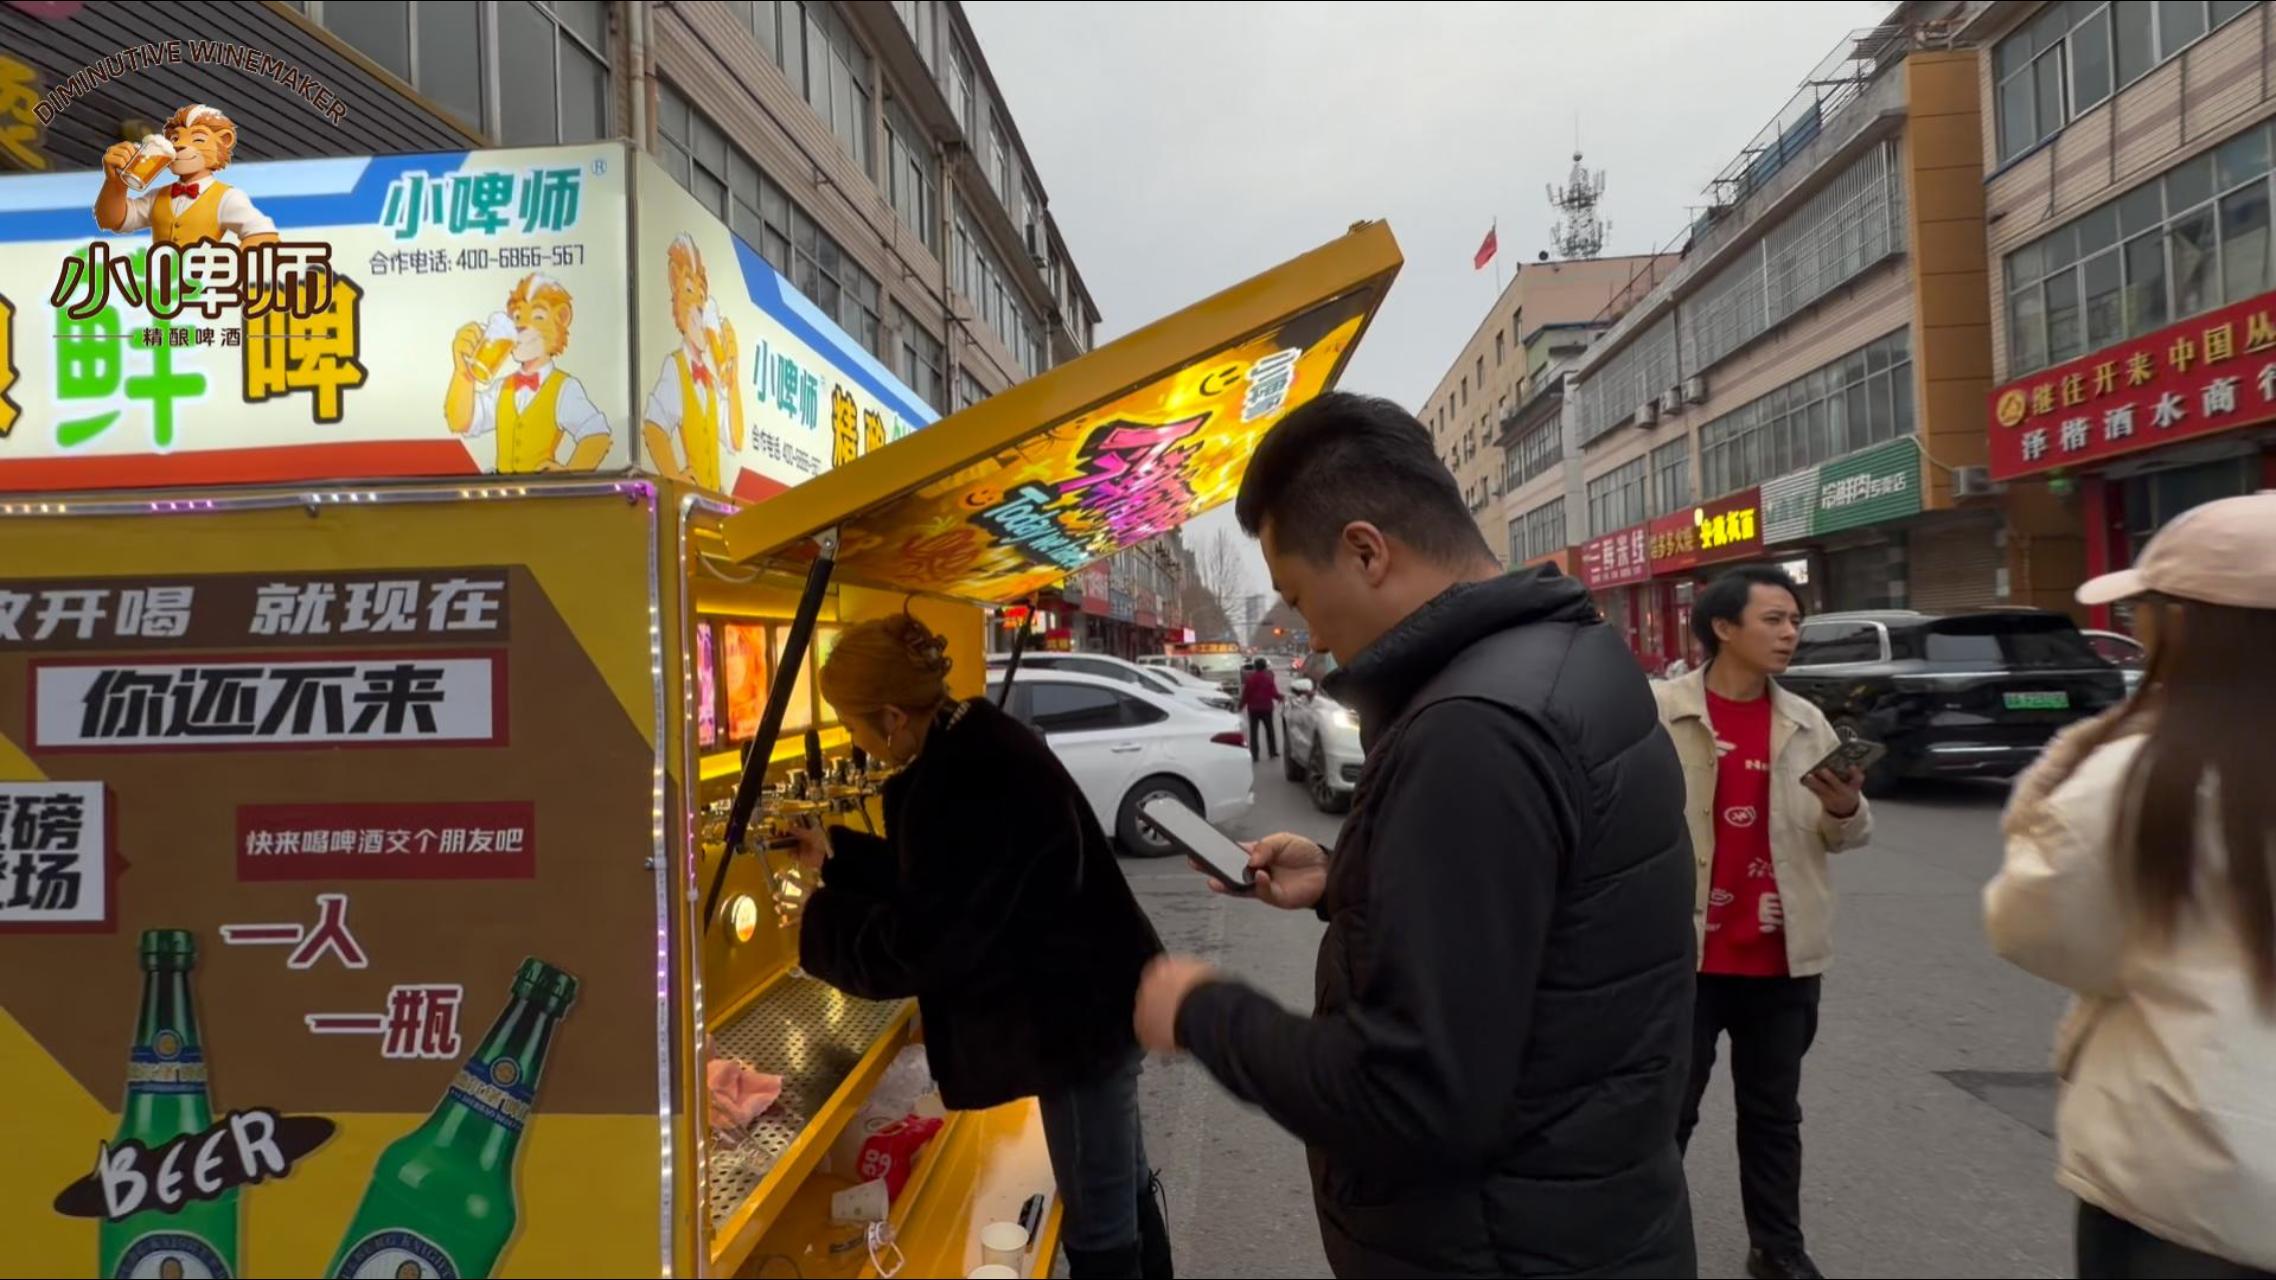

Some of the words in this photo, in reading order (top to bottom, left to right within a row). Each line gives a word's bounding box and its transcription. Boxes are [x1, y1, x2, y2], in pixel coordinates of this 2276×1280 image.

[383, 167, 582, 240] 小啤师
[753, 340, 818, 431] 小啤师
[249, 578, 505, 637] 就现在
[79, 664, 445, 739] 你还不来
[0, 793, 84, 853] 磅
[245, 827, 525, 857] 快来喝啤酒交个朋友吧
[0, 853, 83, 911] 场
[220, 894, 368, 969] 一人
[305, 984, 464, 1059] 一瓶
[99, 1109, 286, 1220] BEER
